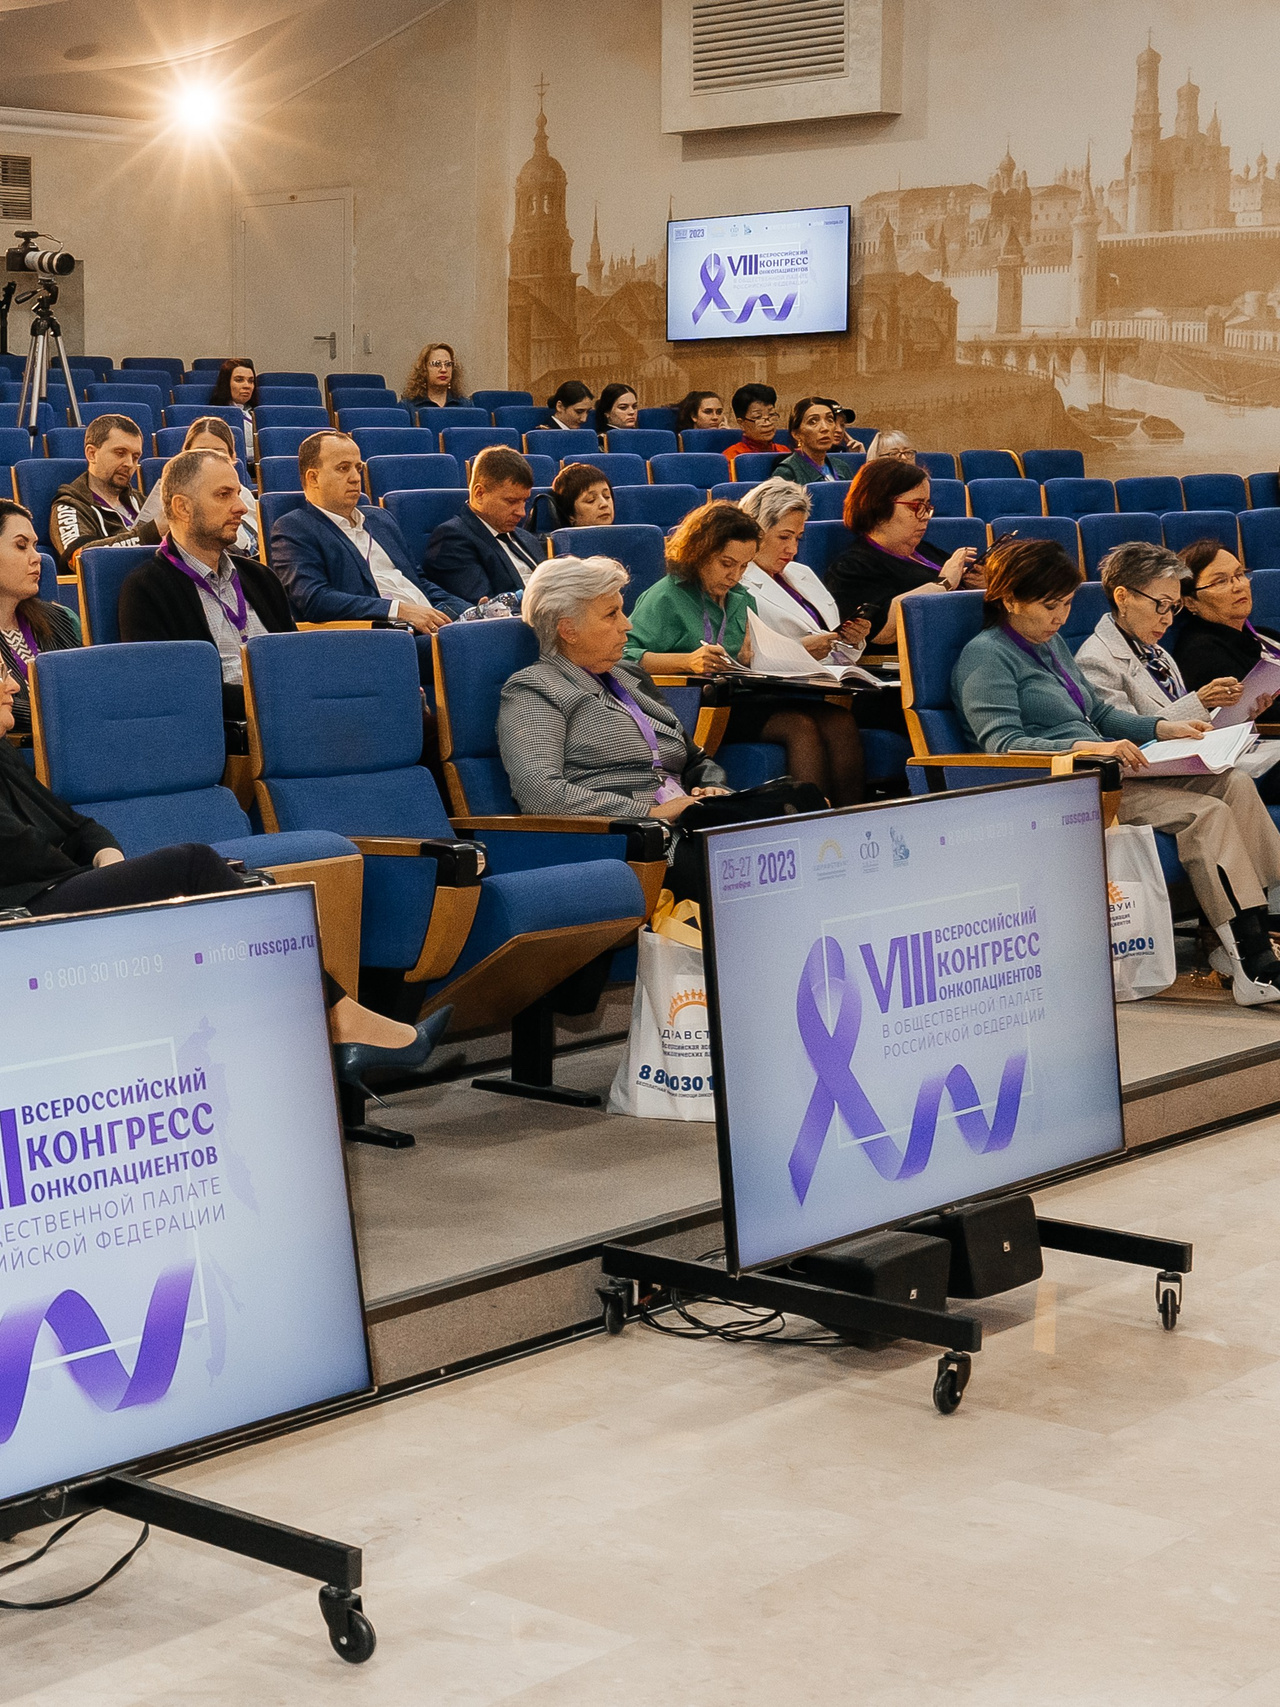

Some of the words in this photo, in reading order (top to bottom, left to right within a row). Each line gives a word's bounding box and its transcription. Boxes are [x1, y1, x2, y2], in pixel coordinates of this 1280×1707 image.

[689, 229, 705, 239] 2023
[727, 254, 758, 276] VIII
[759, 249, 808, 258] ВСЕРОССИЙСКИЙ
[759, 257, 809, 268] КОНГРЕСС
[759, 267, 808, 275] ОНКОПАЦИЕНТОВ
[722, 856, 751, 880] 25-27
[757, 849, 796, 884] 2023
[723, 880, 751, 892] октября
[934, 905, 1037, 944] ВСЕРОССИЙСКИЙ
[208, 933, 315, 964] info@russcpa.ru
[937, 932, 1040, 977] КОНГРЕСС
[57, 965, 86, 988] 800
[90, 962, 109, 982] 30
[113, 959, 128, 978] 10
[132, 956, 150, 977] 20
[858, 930, 937, 1014] VIII
[938, 964, 1042, 1000] ОНКОПАЦИЕНТОВ
[882, 1023, 890, 1039] В
[894, 997, 996, 1036] ОБЩЕСТВЕННОЙ
[999, 987, 1044, 1010] ПАЛАТЕ
[883, 1023, 969, 1059] РОССИЙСКОЙ
[973, 1007, 1046, 1036] ФЕДЕРАЦИИ
[21, 1067, 208, 1126] ВСЕРОССИЙСКИЙ
[26, 1102, 215, 1172] КОНГРЕСС
[30, 1146, 218, 1203] ОНКОПАЦИЕНТОВ
[143, 1176, 222, 1211] ПАЛАТЕ
[95, 1203, 226, 1250] ФЕДЕРАЦИИ
